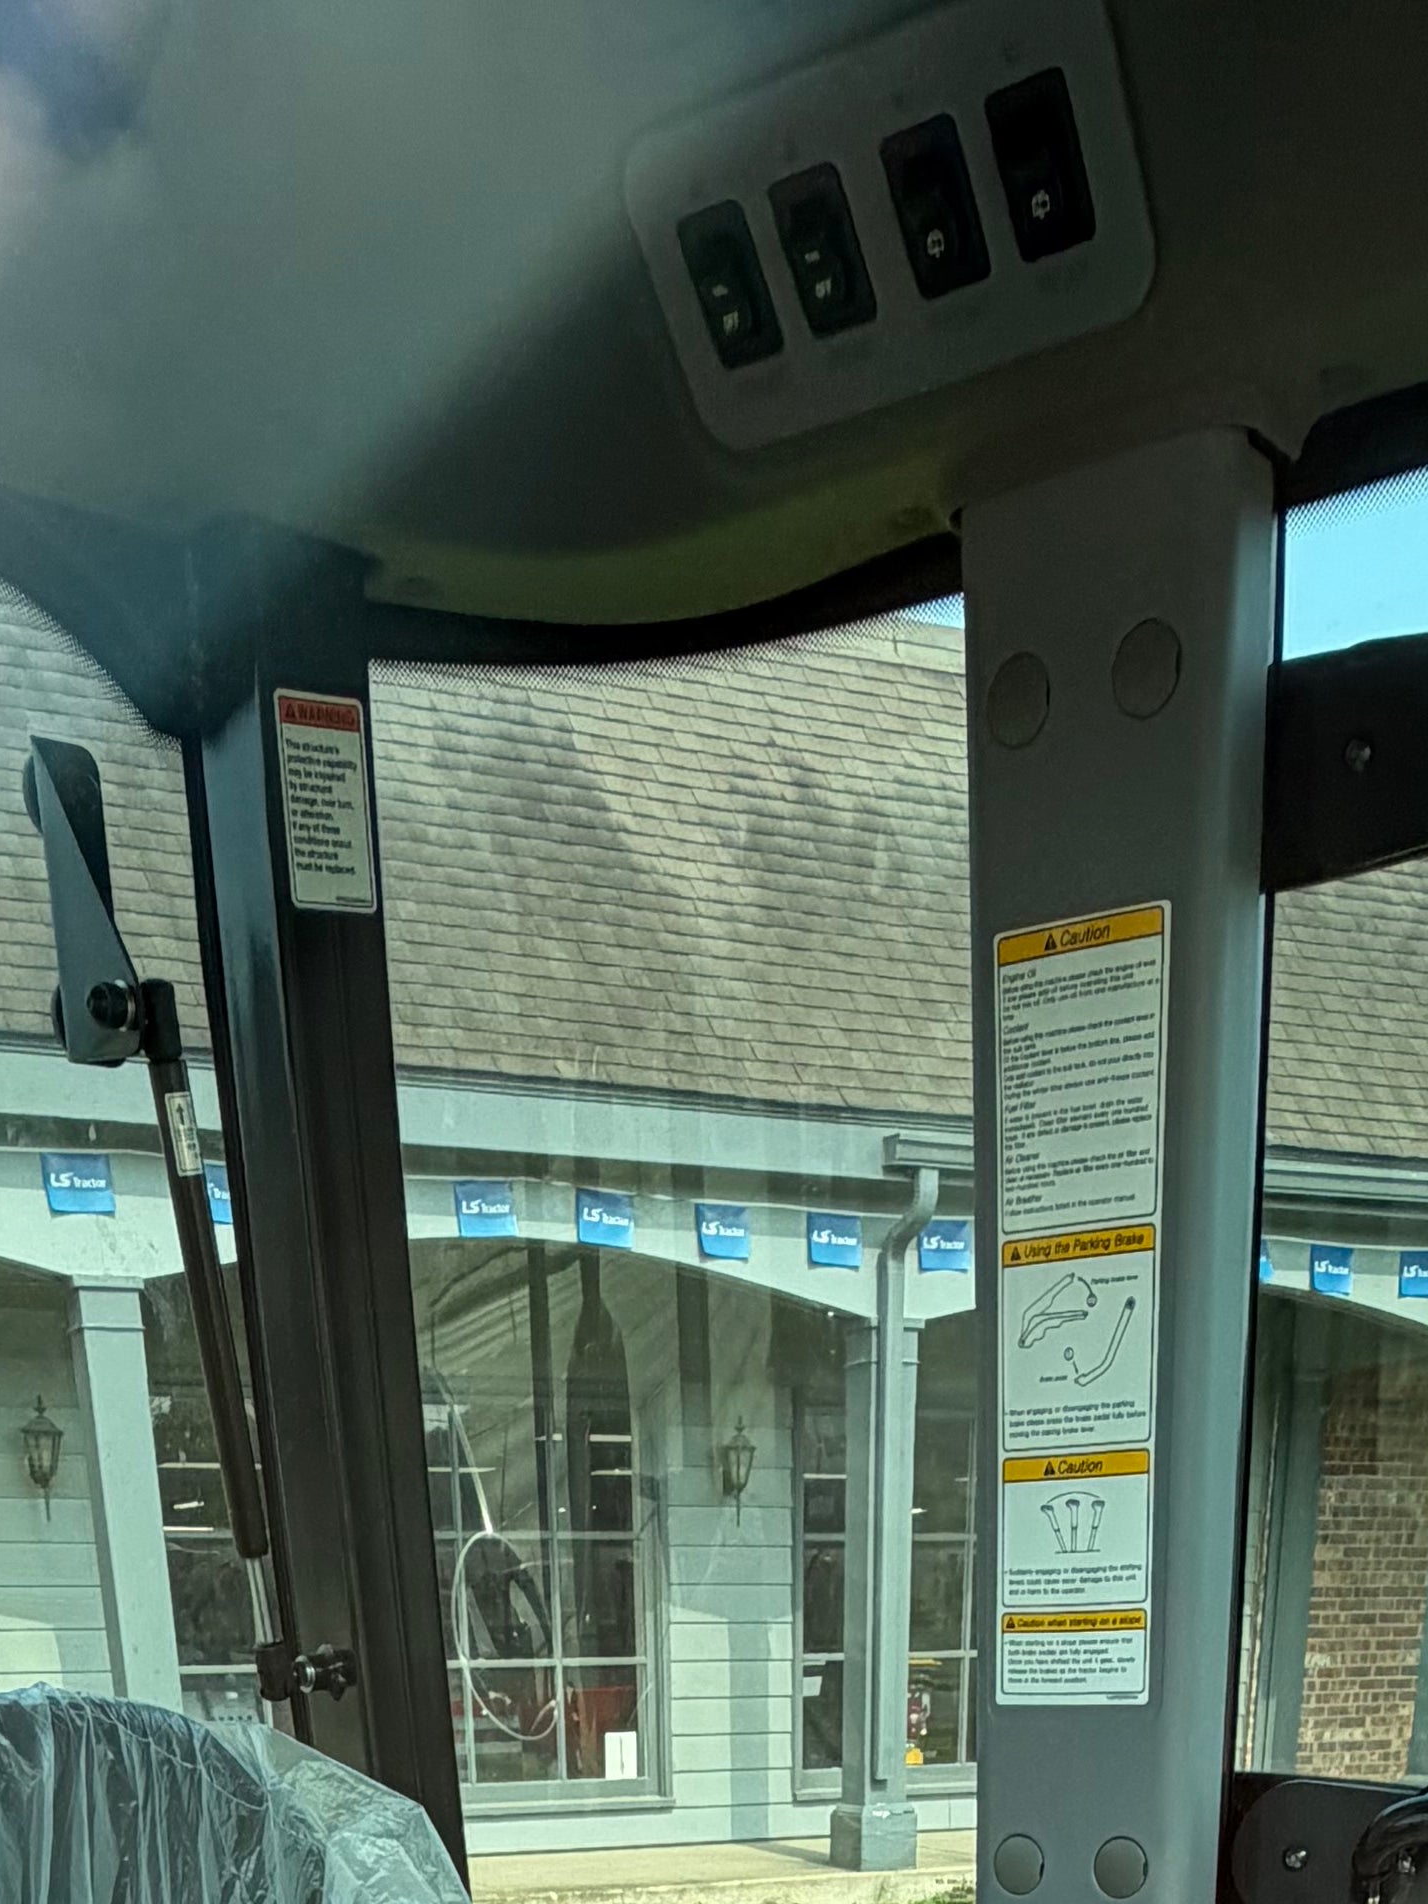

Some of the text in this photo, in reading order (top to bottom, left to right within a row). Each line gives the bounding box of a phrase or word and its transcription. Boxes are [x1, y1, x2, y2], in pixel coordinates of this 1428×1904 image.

[1060, 926, 1110, 947] Caution
[50, 1172, 106, 1189] LS Tractor
[462, 1199, 481, 1214] LS
[583, 1207, 603, 1222] LS
[701, 1221, 720, 1234] LS
[812, 1229, 832, 1244] LS
[1024, 1233, 1145, 1258] Using the Parking Brake
[1058, 1460, 1103, 1475] Caution
